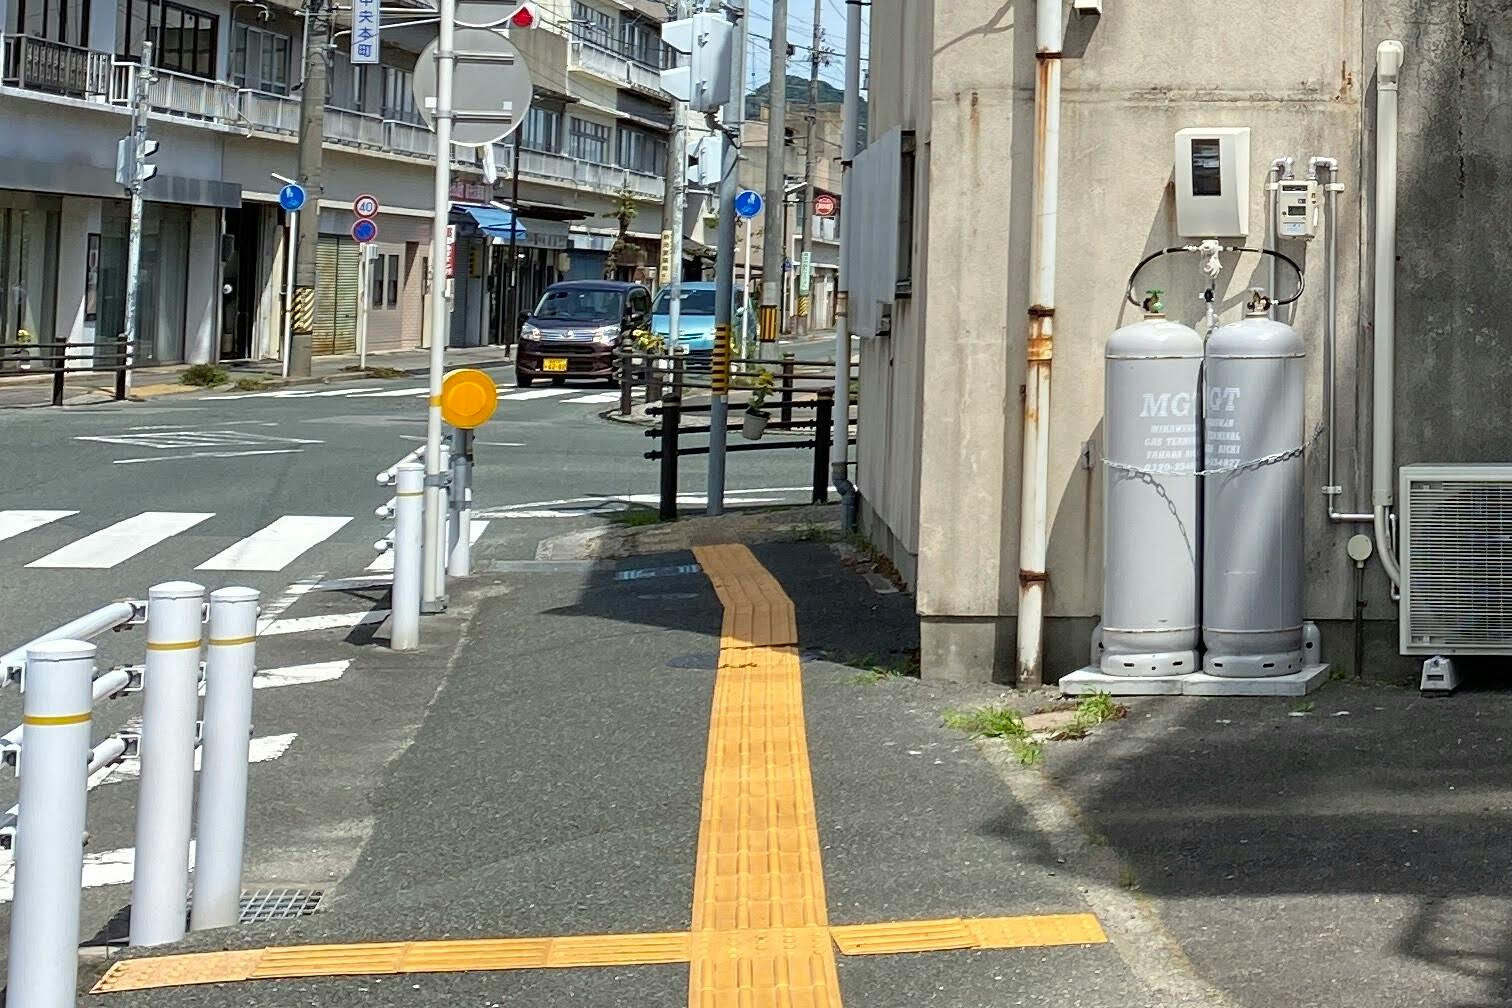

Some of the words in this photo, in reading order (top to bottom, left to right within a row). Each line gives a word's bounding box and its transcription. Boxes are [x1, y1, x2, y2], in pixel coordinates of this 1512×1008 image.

[359, 202, 373, 212] 40
[1140, 392, 1195, 417] MG
[1207, 387, 1240, 411] GT
